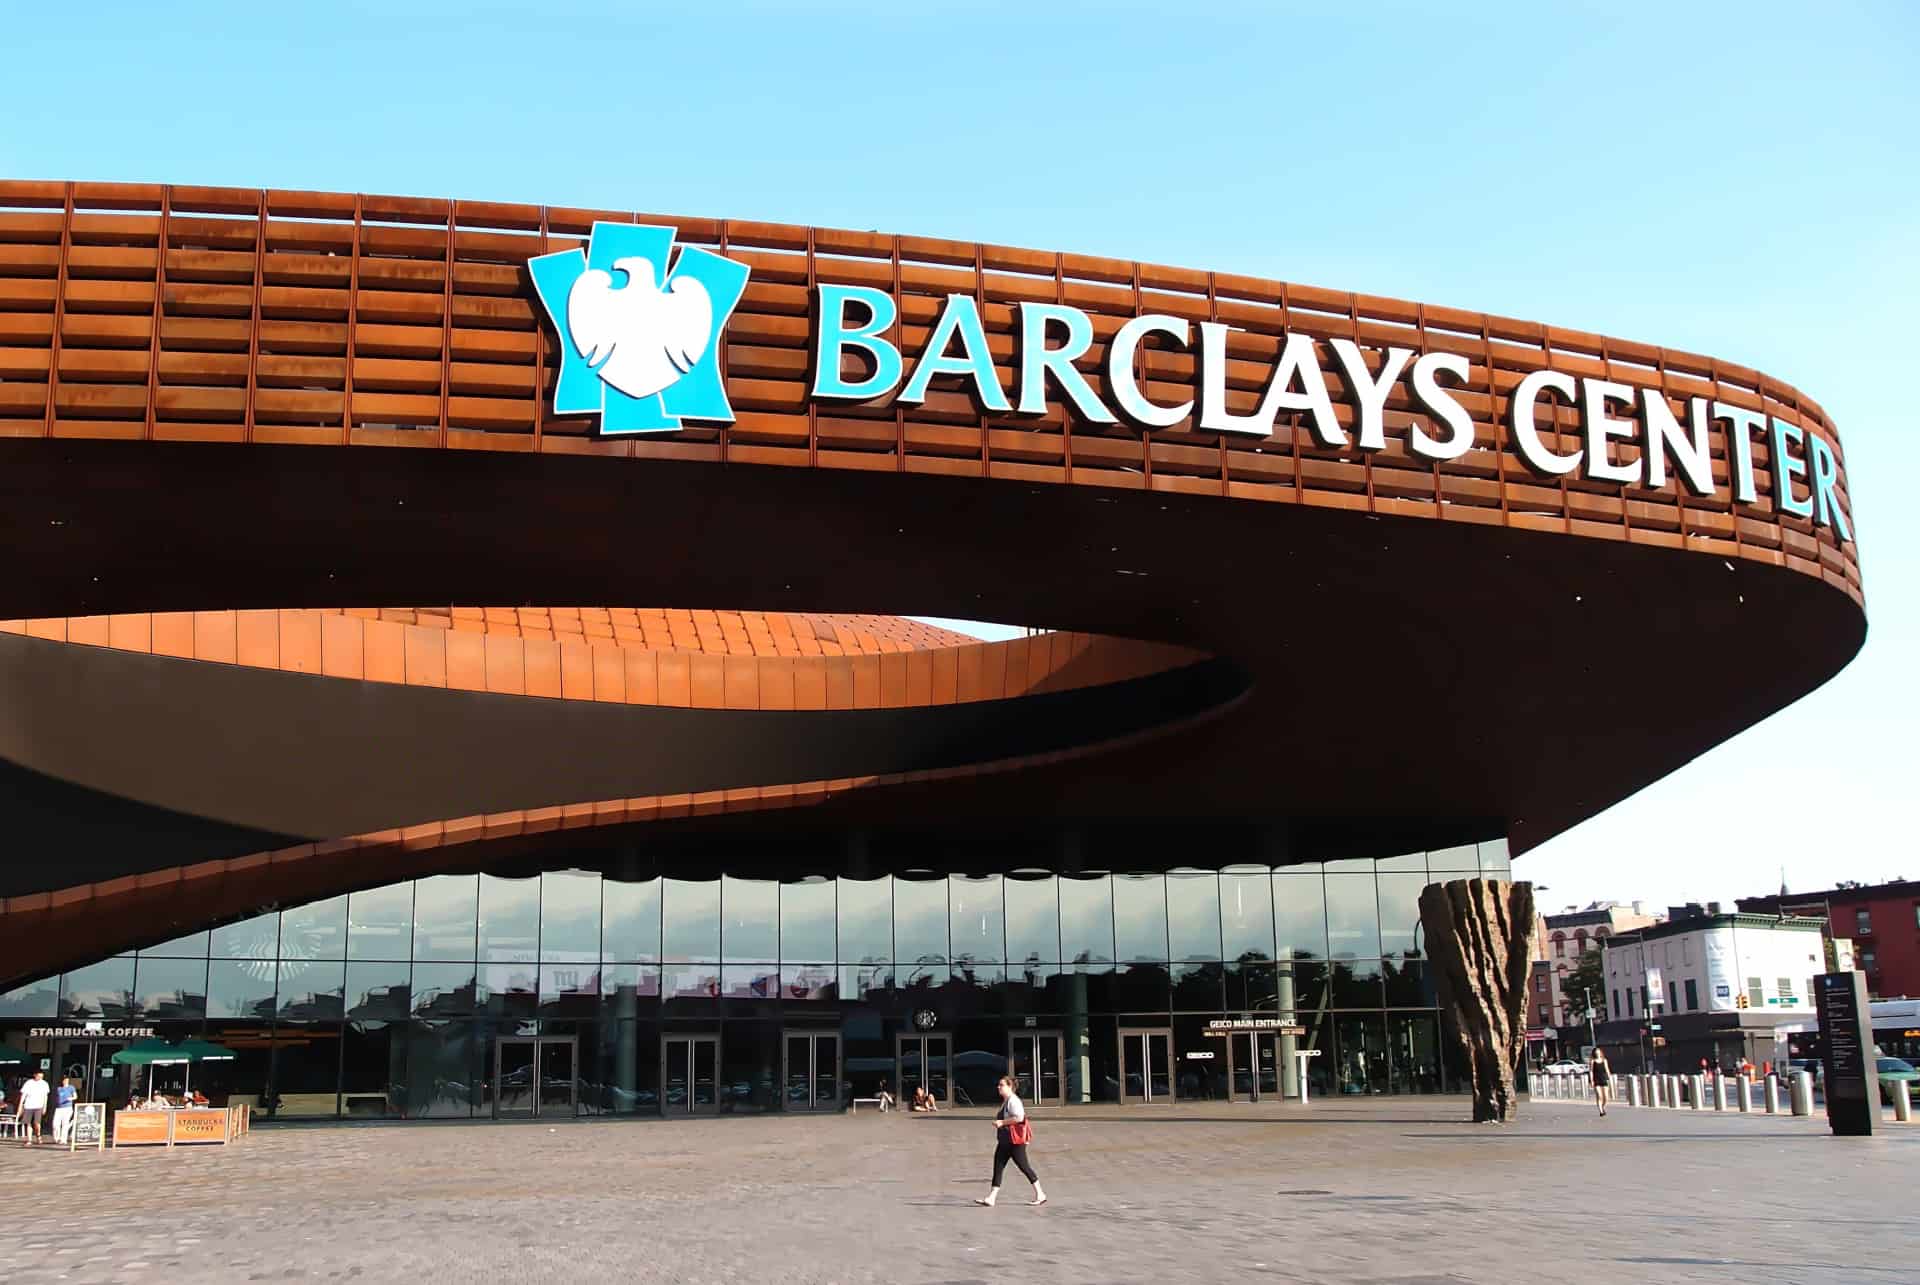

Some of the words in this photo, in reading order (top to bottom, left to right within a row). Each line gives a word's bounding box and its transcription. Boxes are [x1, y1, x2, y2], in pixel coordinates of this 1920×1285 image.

[811, 283, 1475, 460] BARCLAYS
[1513, 370, 1852, 542] CENTER
[1210, 1020, 1232, 1028] GEICO
[1233, 1019, 1254, 1027] MAIN
[1256, 1018, 1297, 1027] ENTRANCE
[30, 1027, 105, 1036] STARBUCKS
[108, 1027, 154, 1036] COFFEE
